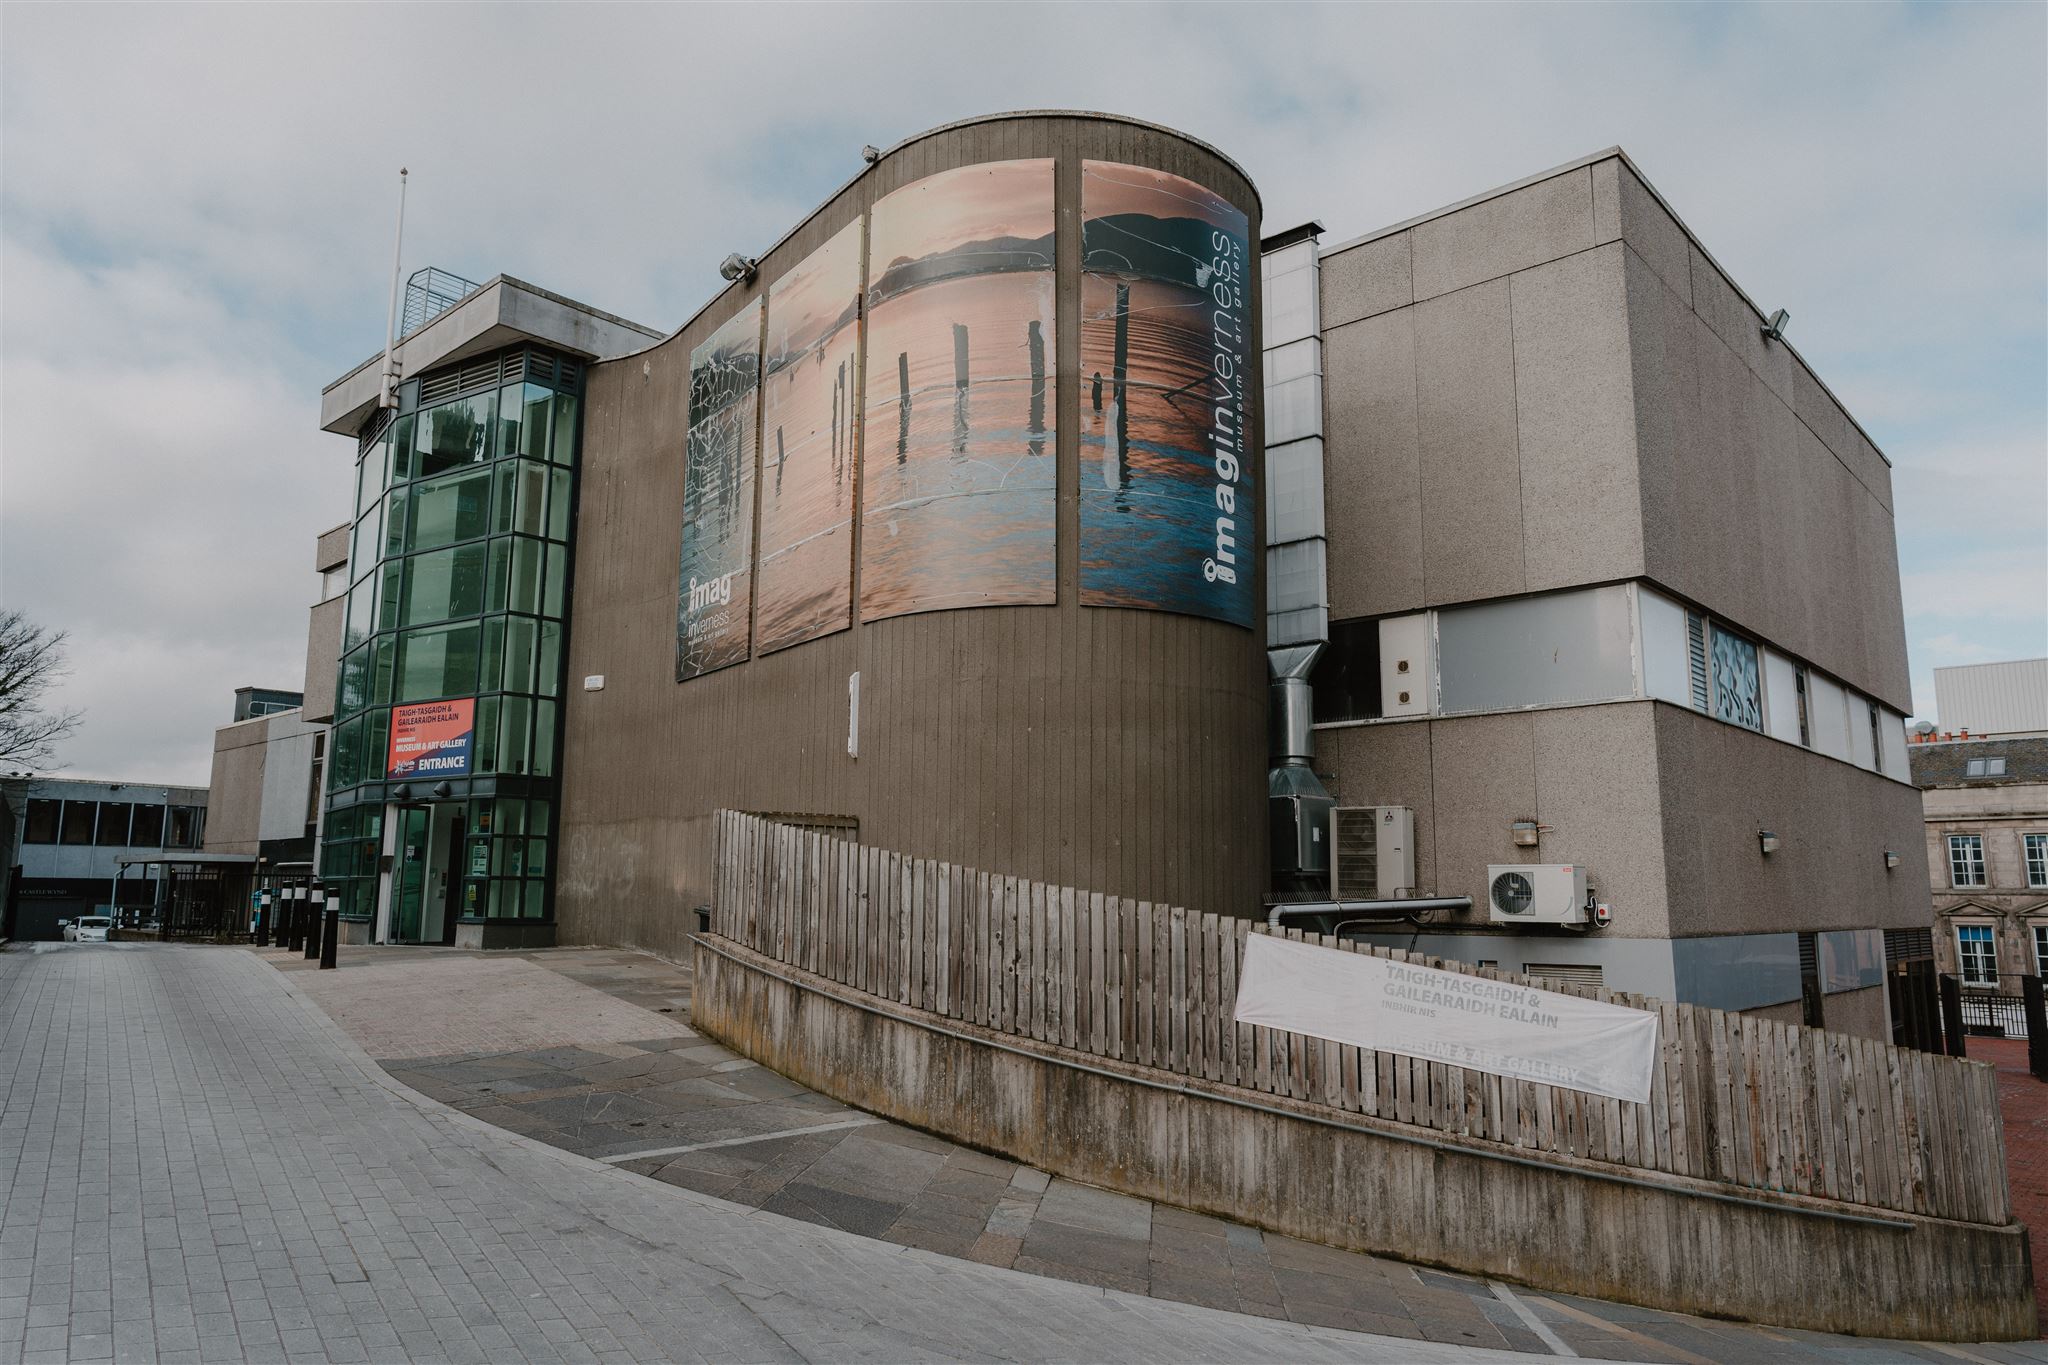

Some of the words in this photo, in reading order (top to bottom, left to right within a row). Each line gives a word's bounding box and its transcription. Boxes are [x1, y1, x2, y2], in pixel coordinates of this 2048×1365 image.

[1233, 242, 1242, 309] gallery
[1234, 317, 1242, 344] art
[1235, 354, 1242, 364] &
[1202, 231, 1240, 584] imaginverness
[1236, 374, 1244, 452] museum
[689, 573, 731, 612] imag
[399, 705, 447, 717] TAIGH-TASGAIDH
[437, 713, 459, 722] EALAIN
[396, 742, 421, 752] MUSEUM
[427, 741, 440, 750] ART
[440, 738, 467, 748] GALLERY
[418, 756, 465, 770] ENTRANCE
[1386, 965, 1525, 1005] TAIGH-TASGAIDH
[1528, 993, 1541, 1008] &
[1381, 1000, 1417, 1015] INBHIR
[1418, 1007, 1437, 1018] NIS
[1383, 982, 1496, 1016] GAILEARAIDH
[1500, 1005, 1559, 1029] EALAIN
[1507, 1056, 1581, 1082] GALLERY
